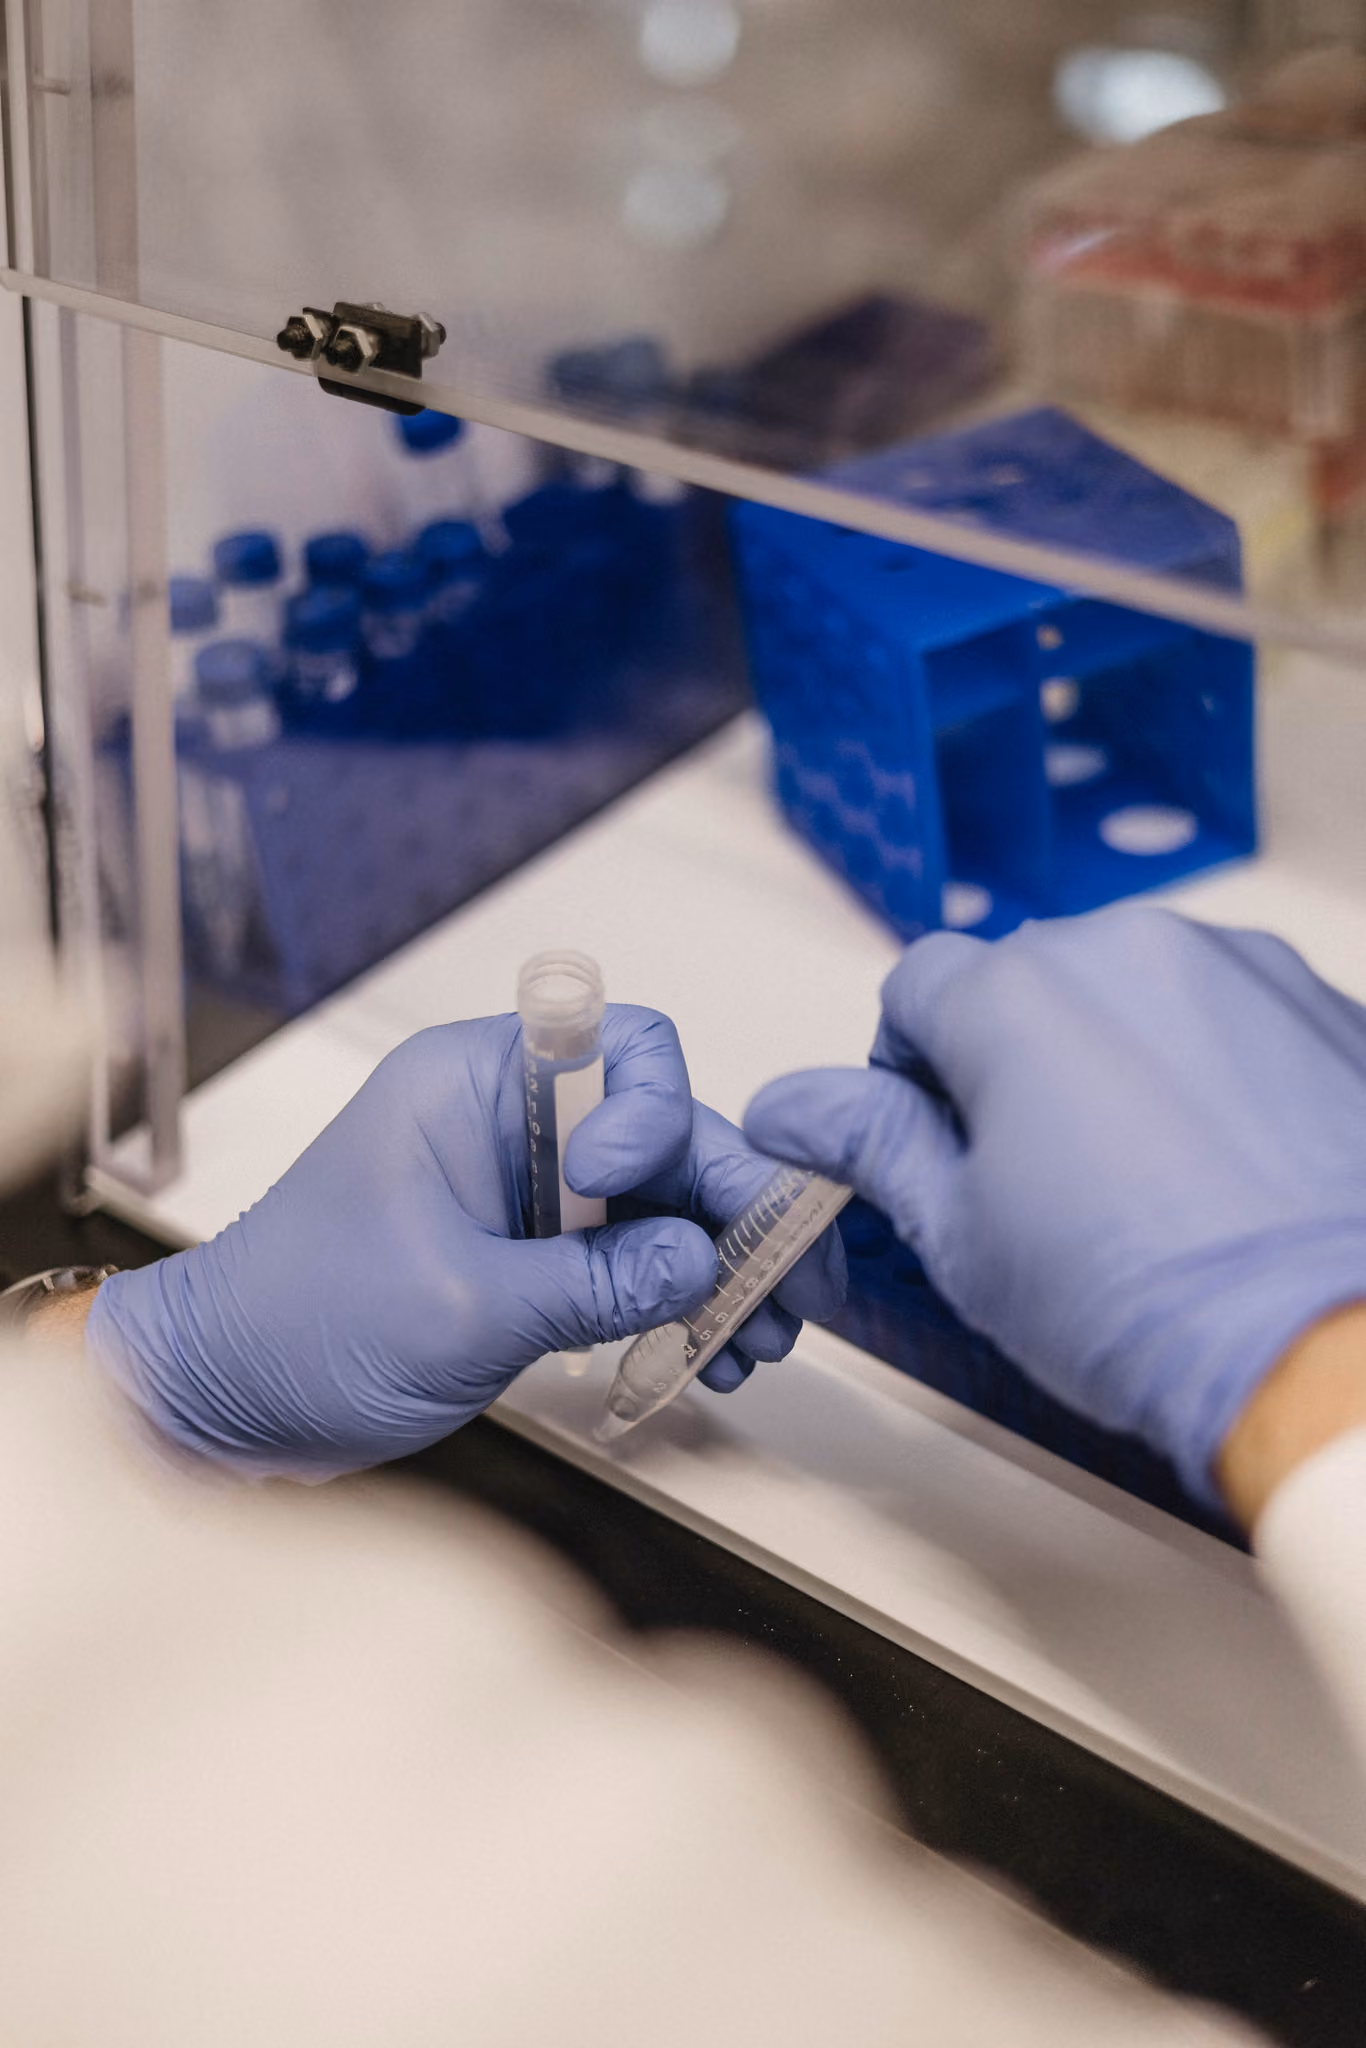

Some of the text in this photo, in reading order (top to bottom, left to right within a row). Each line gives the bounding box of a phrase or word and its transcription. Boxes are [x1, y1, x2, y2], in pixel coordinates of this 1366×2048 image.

[745, 1277, 759, 1289] 8
[731, 1293, 745, 1305] 7
[714, 1312, 729, 1323] 6
[699, 1329, 713, 1341] 5
